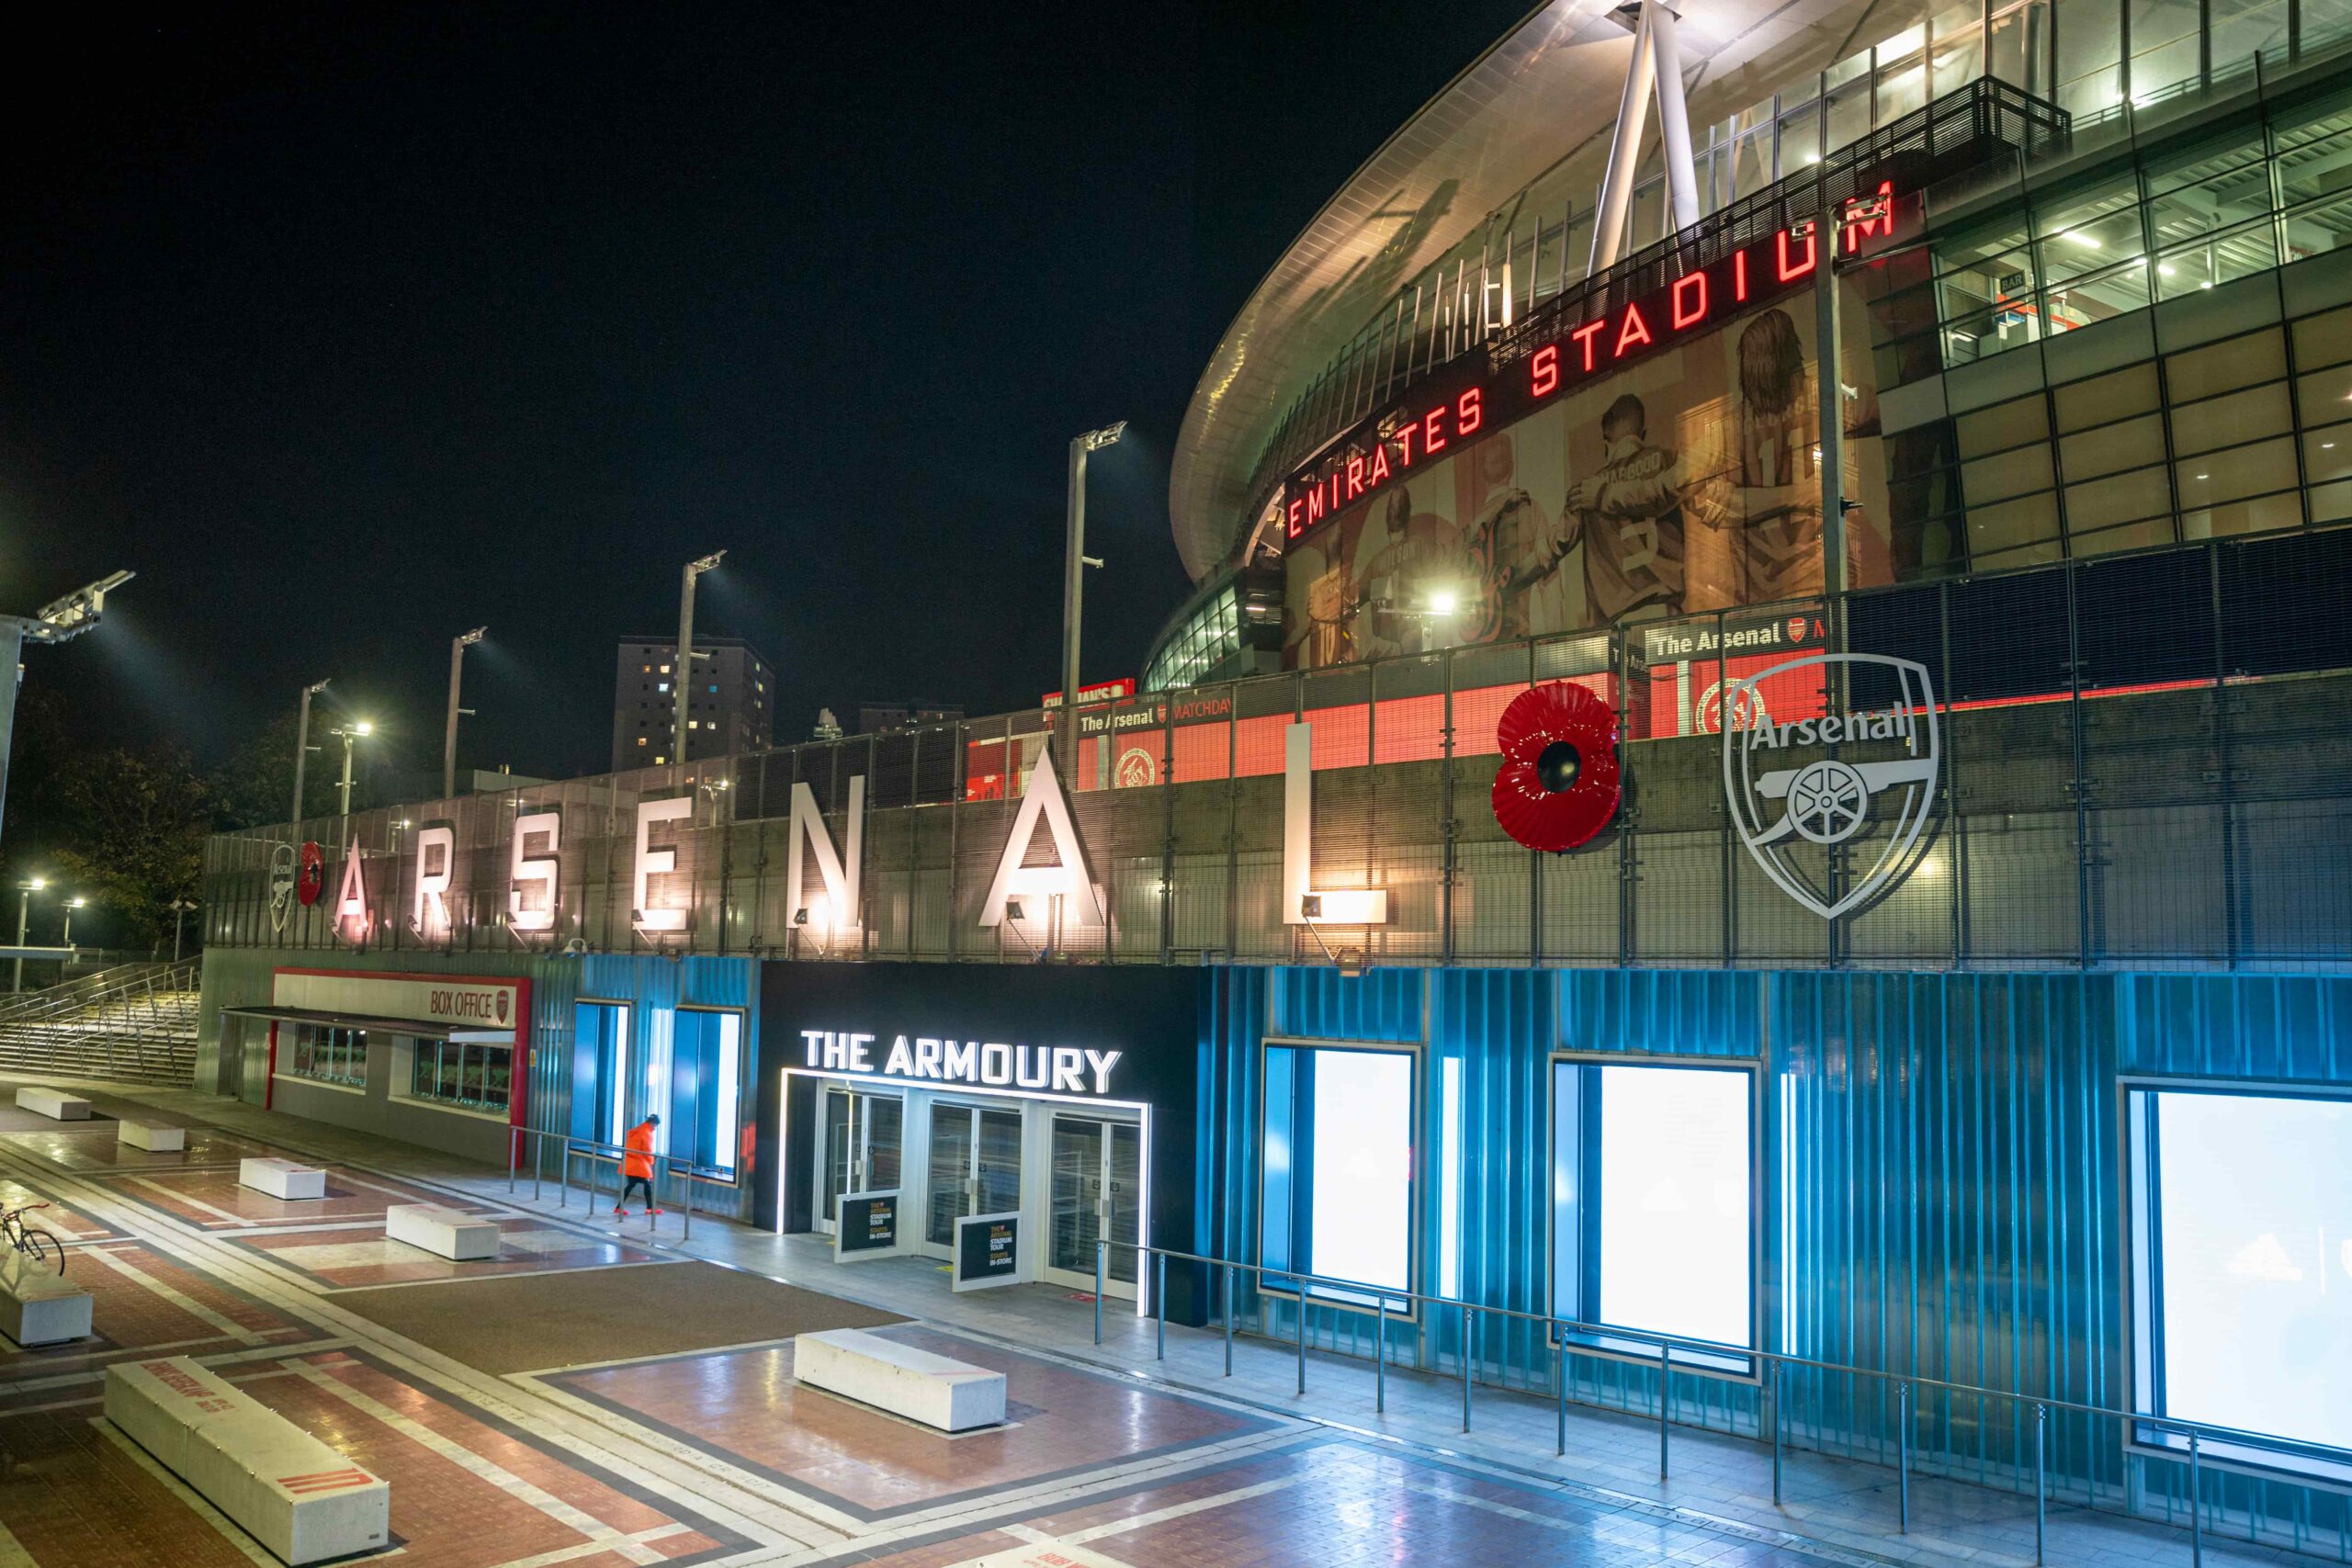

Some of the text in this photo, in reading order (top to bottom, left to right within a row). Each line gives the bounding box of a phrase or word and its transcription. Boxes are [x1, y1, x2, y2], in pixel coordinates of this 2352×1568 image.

[2002, 275, 2022, 290] BAR
[1288, 180, 1894, 539] EMIRATES STADIUM
[1657, 621, 1781, 656] The Arsenal
[1081, 715, 1103, 732] The
[1749, 701, 1906, 751] Arsenal
[334, 722, 1388, 933] ARSENAL
[430, 990, 492, 1019] BOX OFFICE
[800, 1030, 1123, 1094] THE ARMOURY
[870, 1213, 892, 1221] STADIUM
[989, 1236, 1012, 1245] STADIUM
[989, 1243, 1004, 1251] TOUR
[989, 1258, 1012, 1266] IN-STORE
